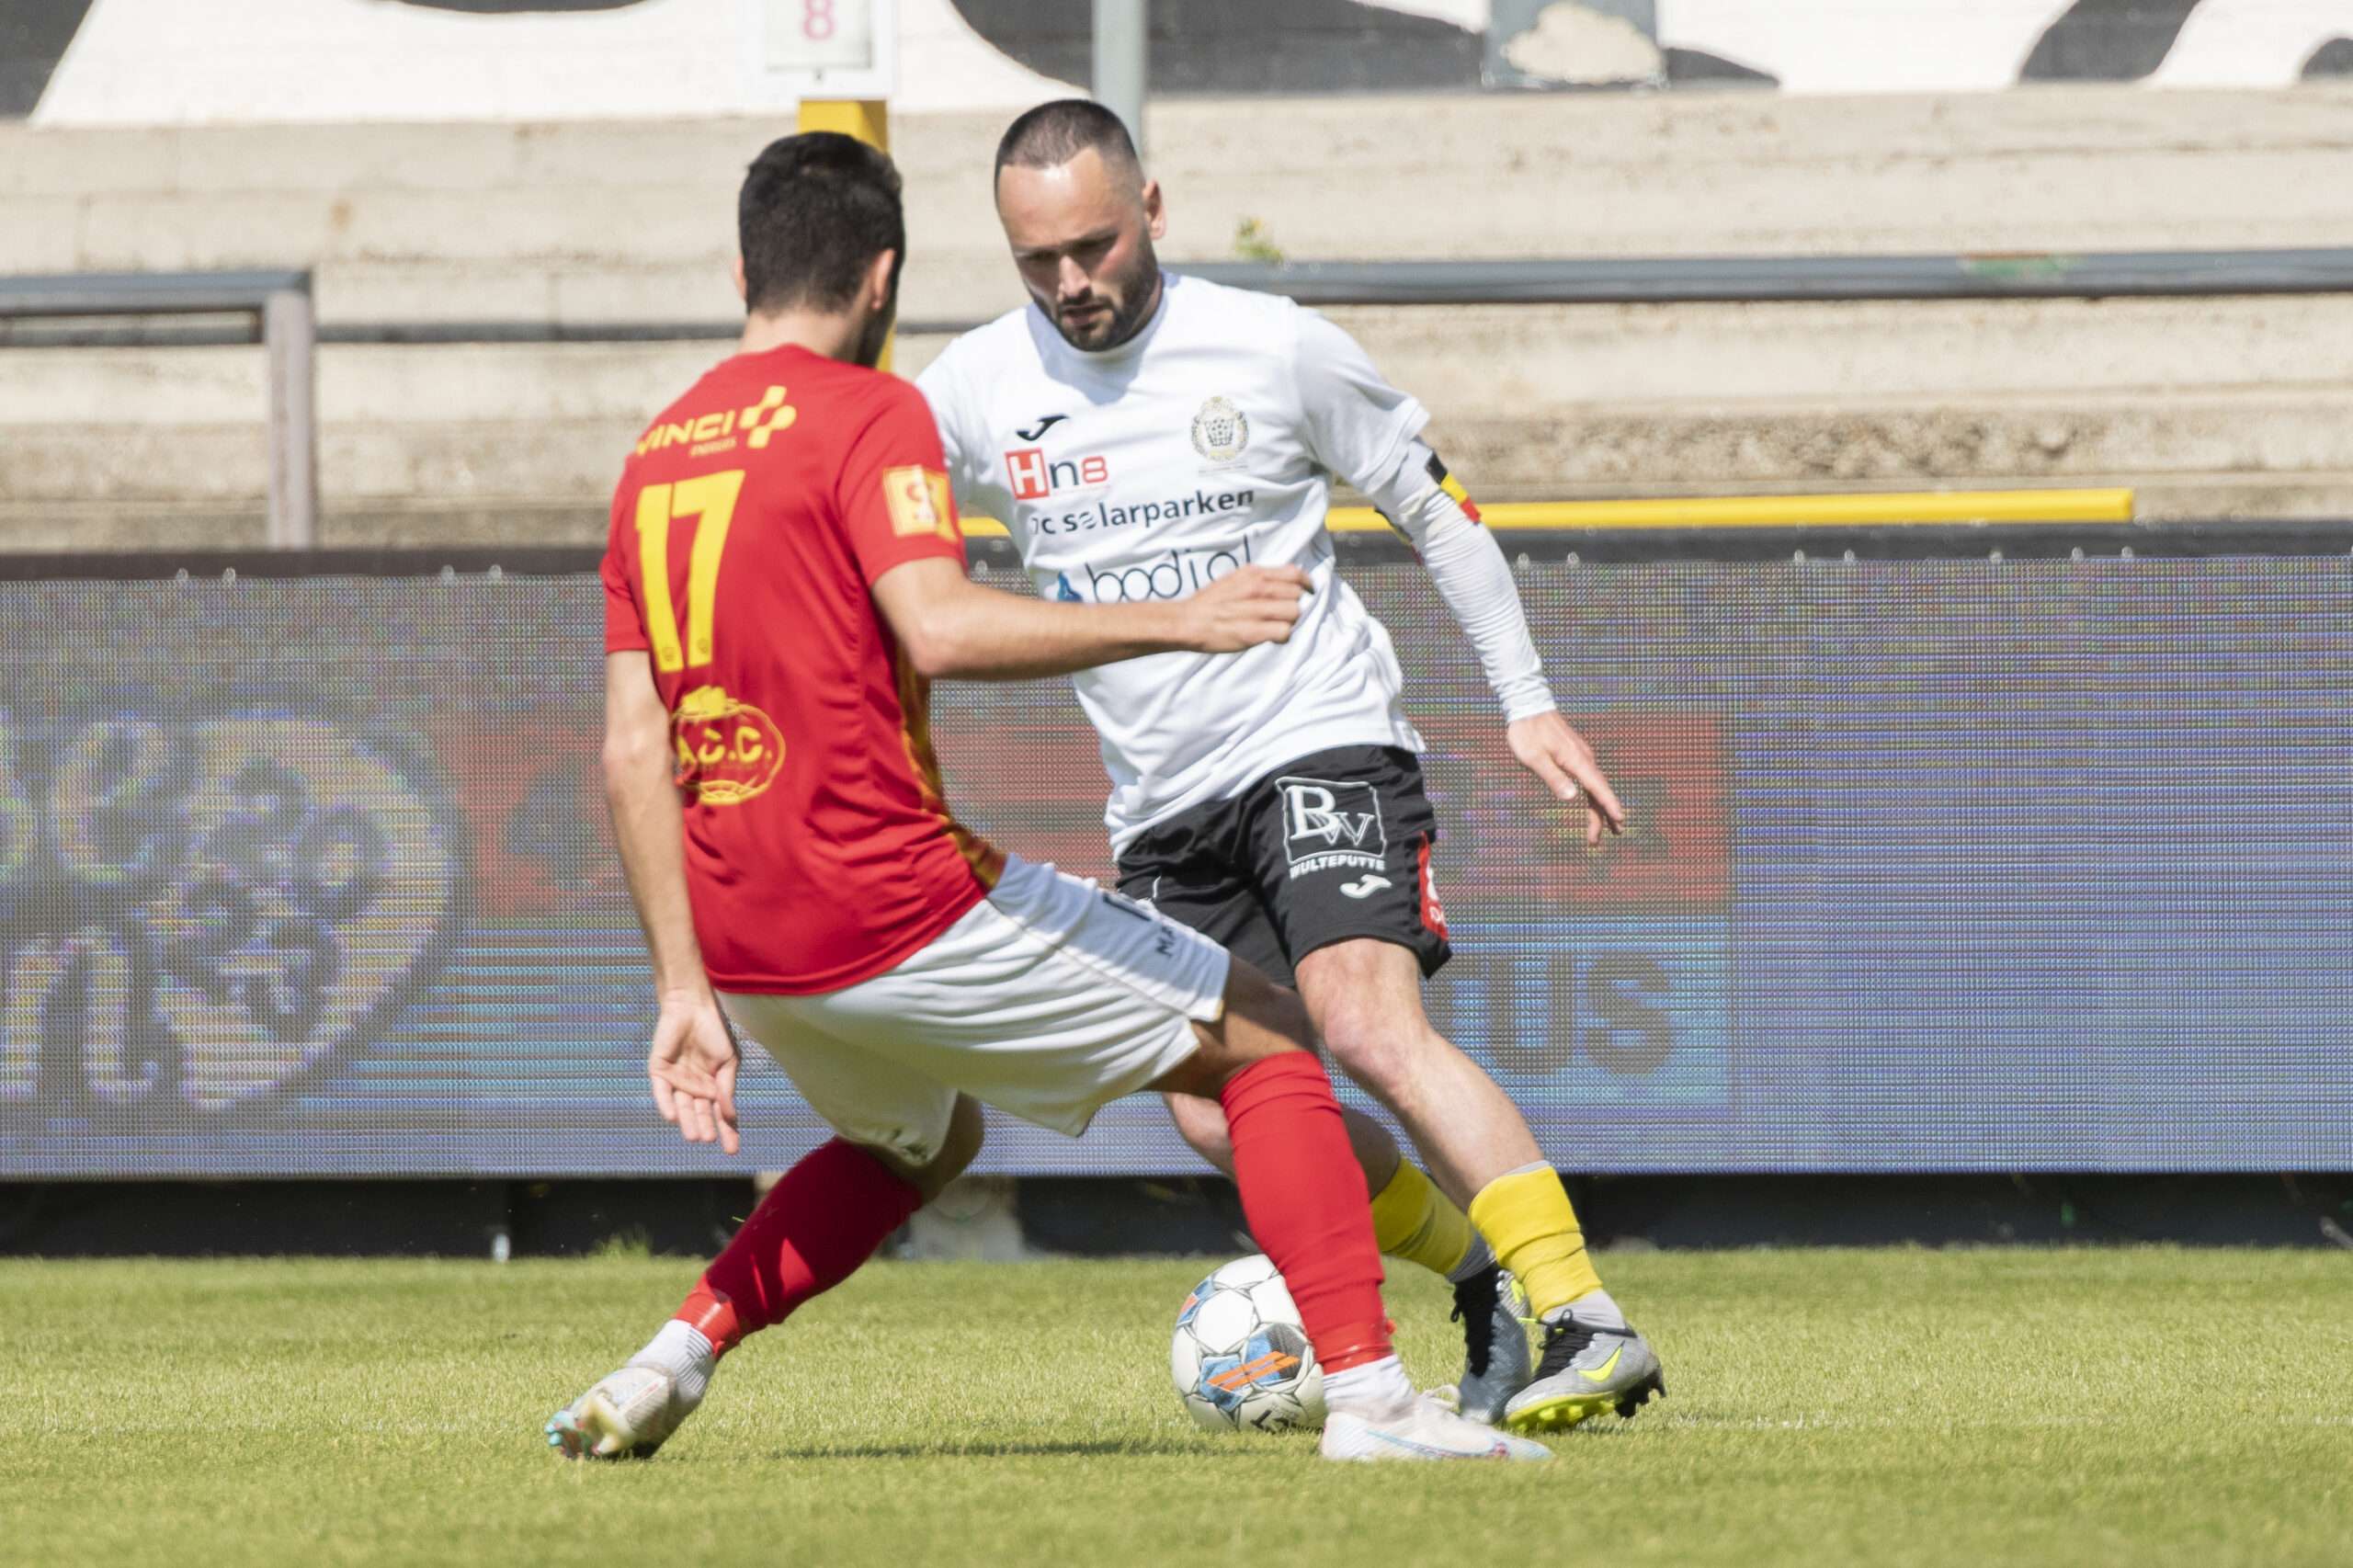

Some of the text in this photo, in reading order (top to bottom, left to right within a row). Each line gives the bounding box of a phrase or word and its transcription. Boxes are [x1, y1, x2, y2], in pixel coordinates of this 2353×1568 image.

[636, 409, 736, 456] VINCI
[1063, 489, 1255, 533] solarparken
[634, 469, 745, 673] 17
[1289, 854, 1387, 881] WULTEPUTTE
